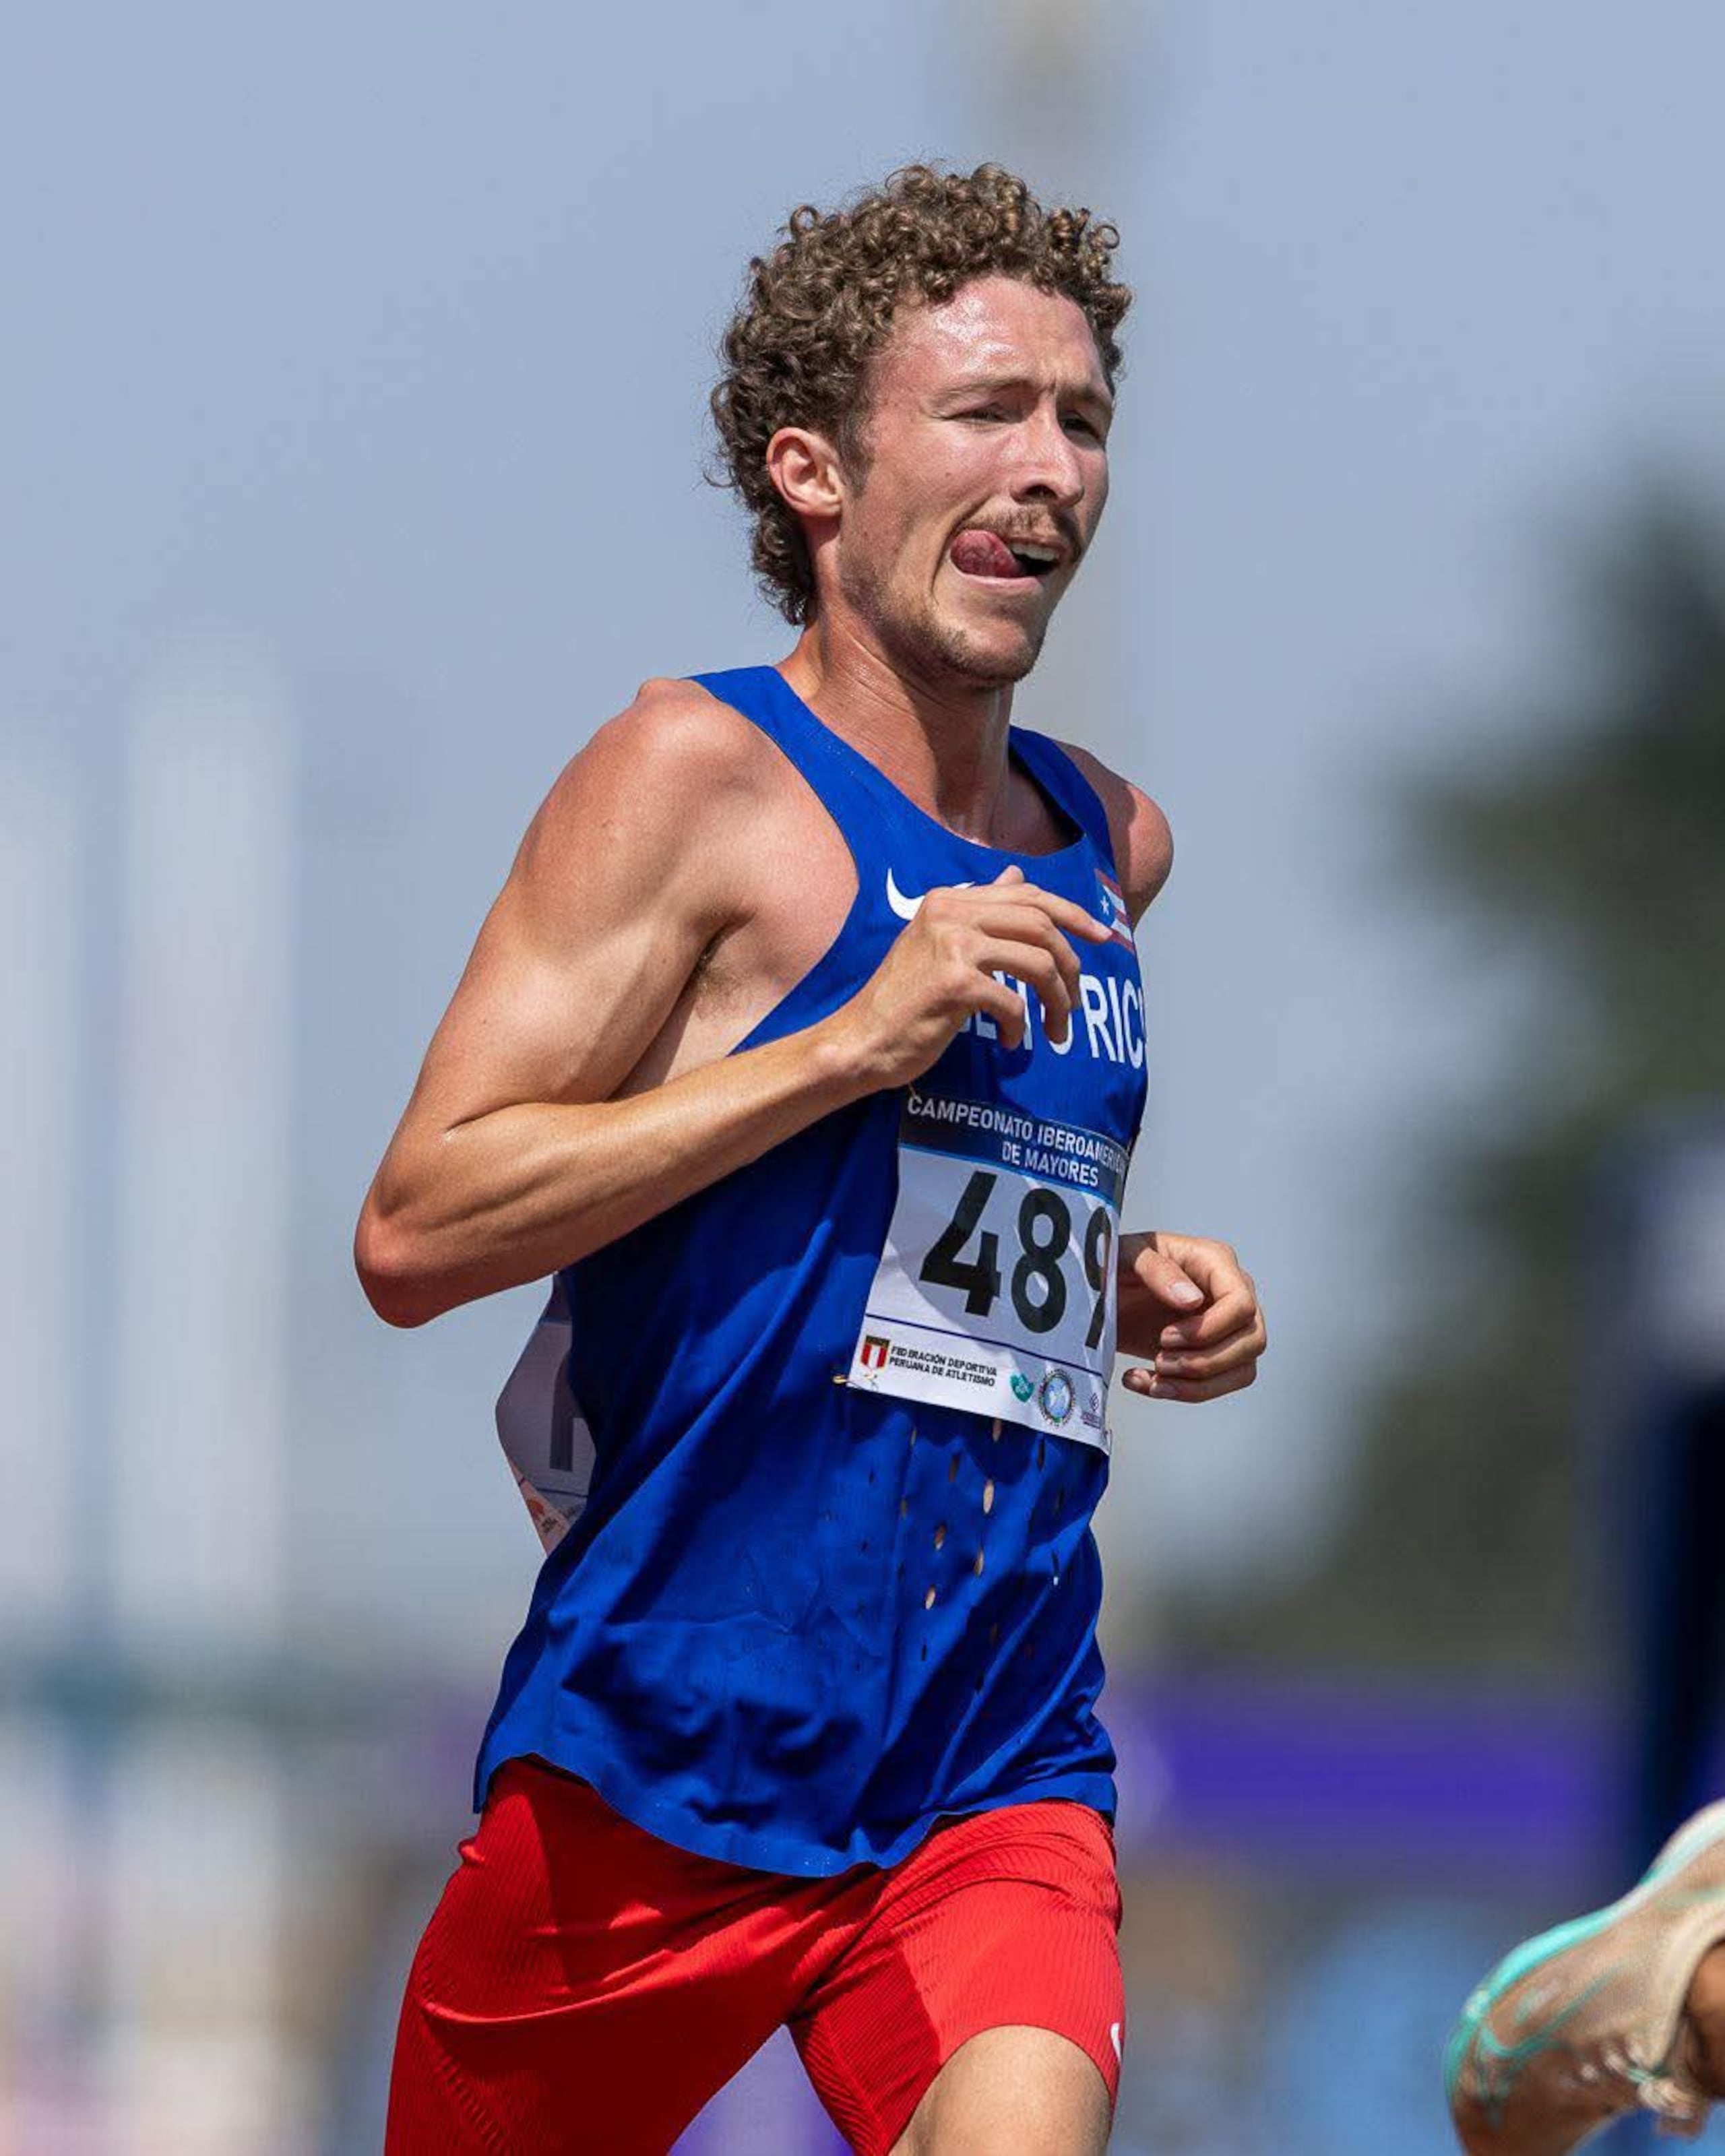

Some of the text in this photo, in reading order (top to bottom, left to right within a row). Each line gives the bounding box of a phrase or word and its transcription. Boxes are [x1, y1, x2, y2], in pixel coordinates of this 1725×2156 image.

[908, 1095, 1032, 1141] CAMPEONATO
[1002, 1141, 1099, 1187] DE MAYORES
[919, 1171, 1112, 1350] 489
[889, 1356, 995, 1387] PERUANA DE ATLETISMO
[891, 1346, 997, 1376] FEDERACIÓN DEPORTIVA
